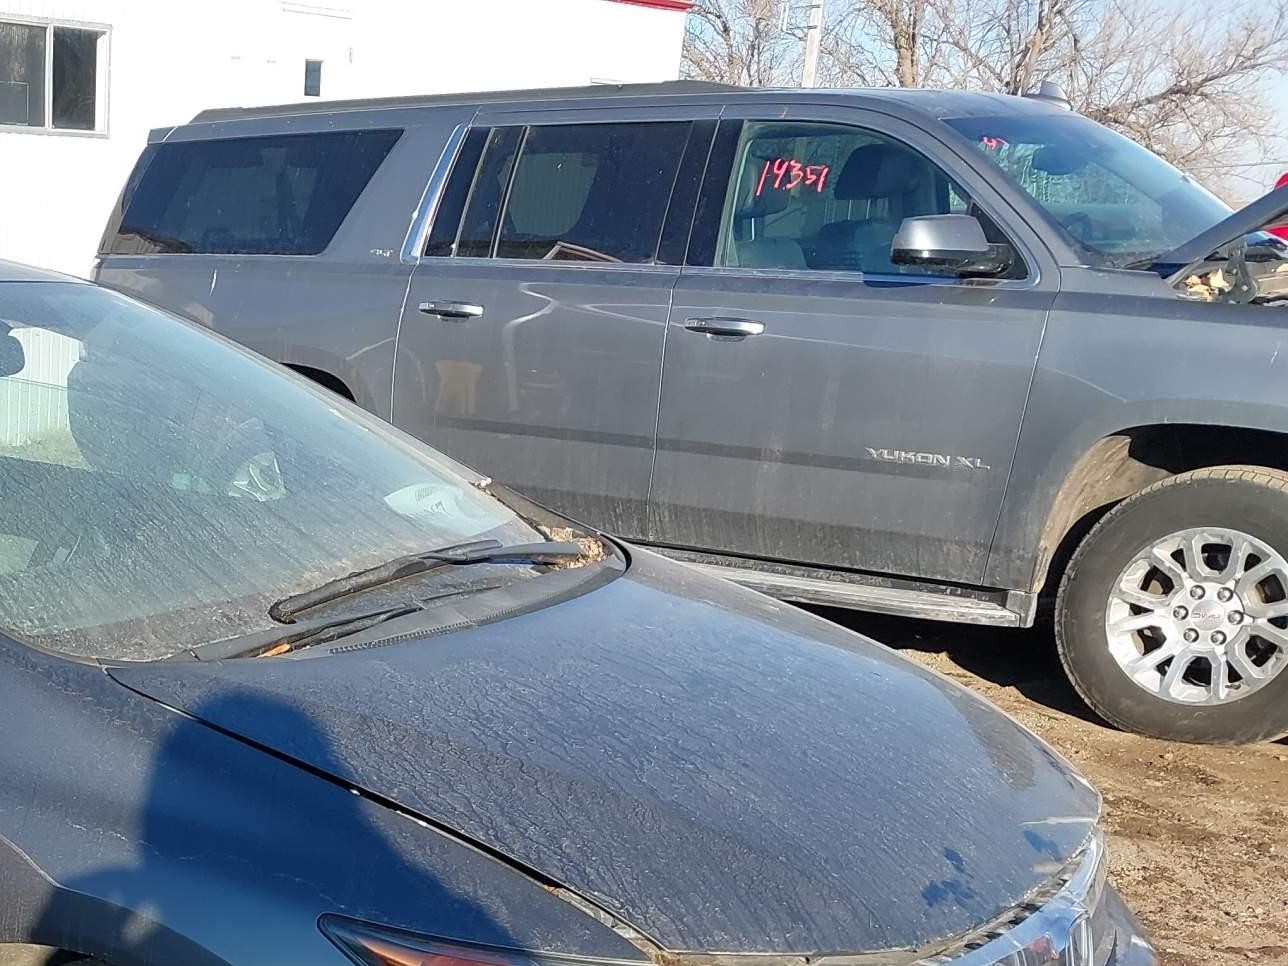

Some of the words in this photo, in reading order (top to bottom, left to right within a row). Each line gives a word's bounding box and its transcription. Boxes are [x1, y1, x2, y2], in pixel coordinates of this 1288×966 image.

[756, 159, 829, 196] 14351
[865, 447, 951, 467] YUKON
[956, 455, 991, 470] XL
